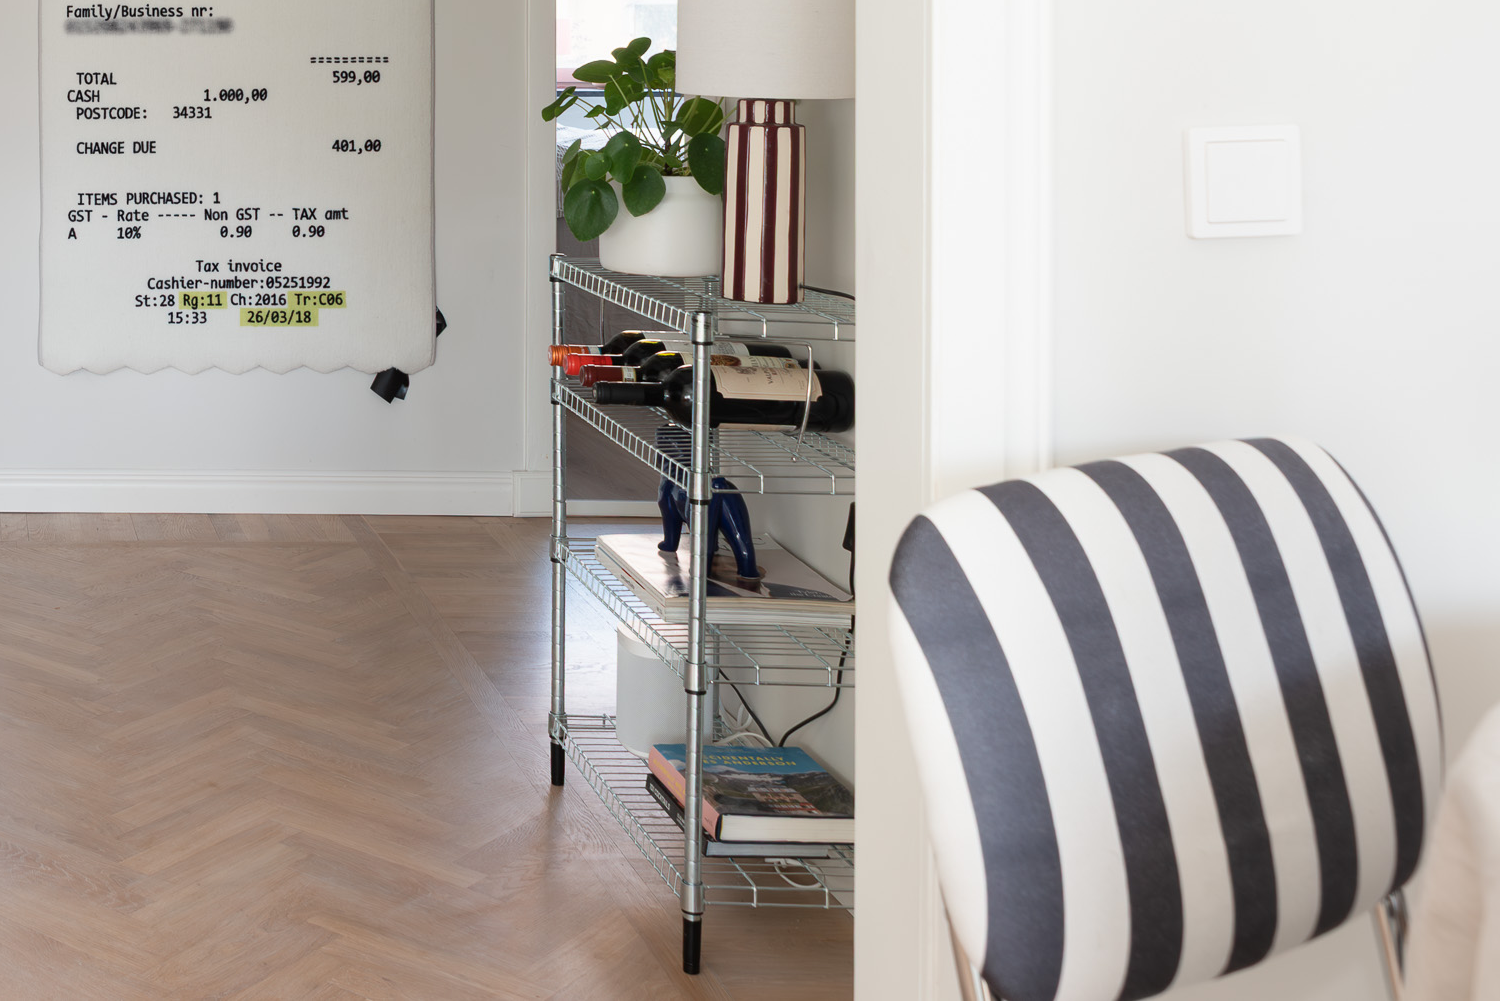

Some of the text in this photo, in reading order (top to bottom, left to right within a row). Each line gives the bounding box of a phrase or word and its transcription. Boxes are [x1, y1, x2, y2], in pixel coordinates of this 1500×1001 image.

[66, 4, 213, 20] Family/Business nr:
[75, 69, 381, 86] TOTAL 599,00
[66, 87, 268, 105] CASH 1.000,00
[76, 105, 213, 120] POSTCODE: 34331
[76, 138, 382, 155] CHANGE DUE 401,00
[77, 191, 221, 206] ITEMS PURCHASED: 1
[67, 209, 93, 223] GST
[117, 209, 150, 223] Rate
[204, 208, 229, 221] Non
[235, 207, 261, 221] GST
[291, 207, 317, 221] TAX
[324, 207, 349, 221] amt
[67, 224, 326, 240] A 10% 0.90 0.90
[195, 258, 283, 273] Tax invoice
[147, 275, 331, 290] Cashier-number:05251992
[134, 292, 344, 311] St:28 Rg:11 Ch:2016 Tr:C06
[167, 308, 312, 325] 15:33 26/03/18
[702, 754, 785, 762] CIDENTALLY
